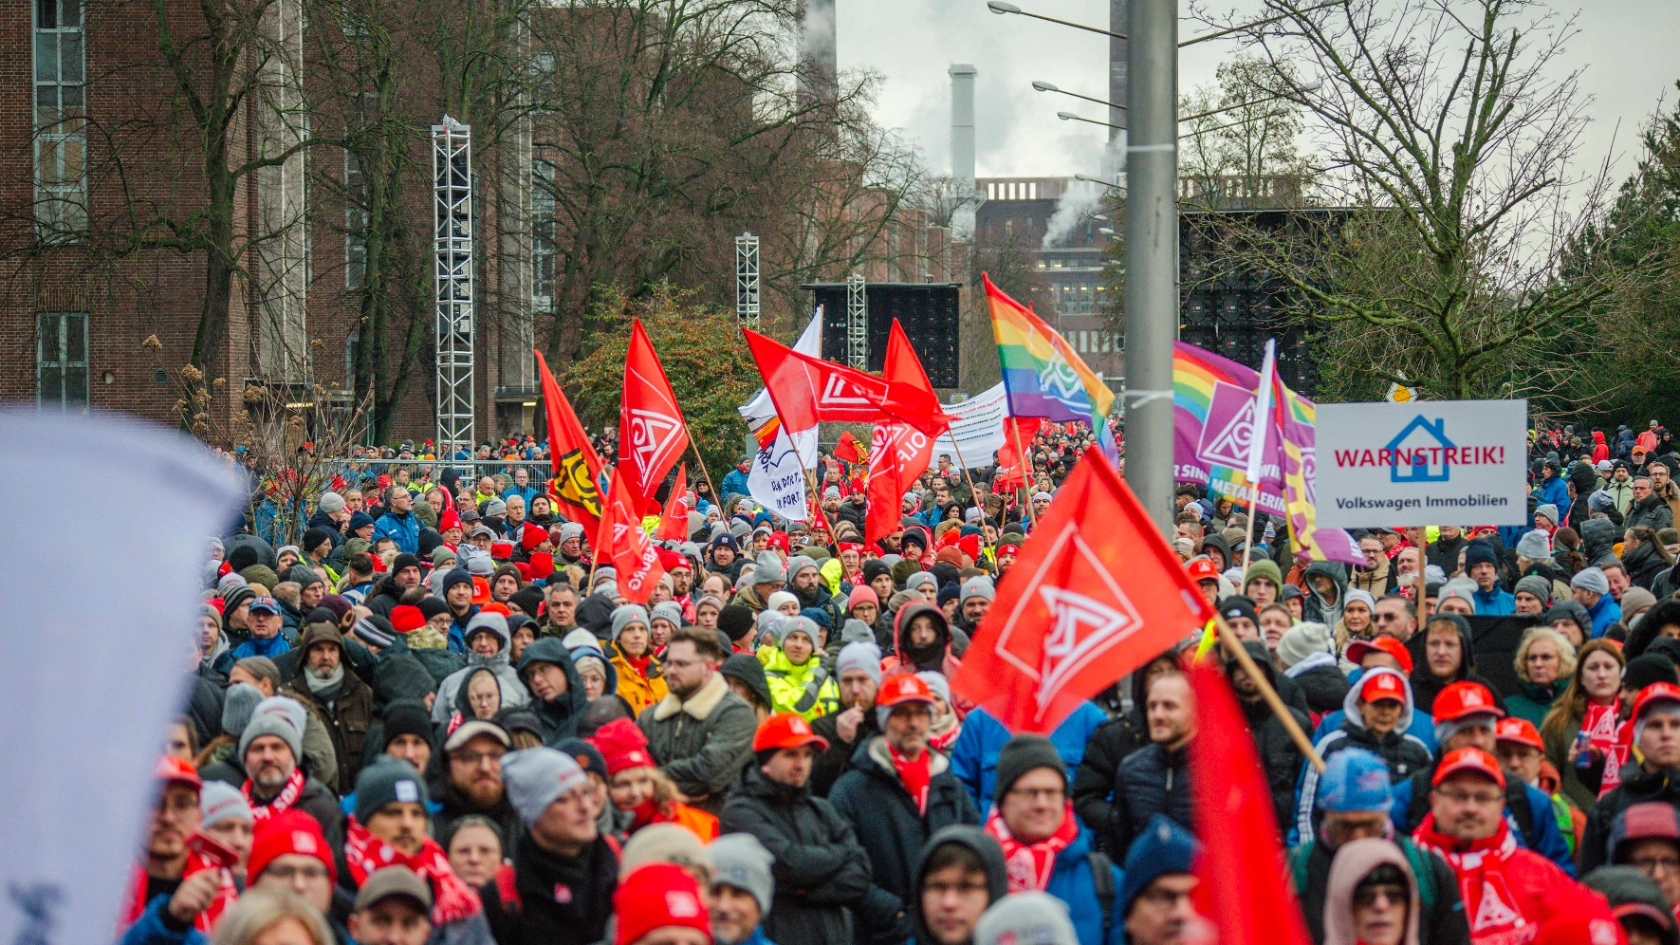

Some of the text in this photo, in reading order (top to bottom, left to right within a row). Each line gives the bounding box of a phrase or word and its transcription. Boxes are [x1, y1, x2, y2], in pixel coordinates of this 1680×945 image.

[1335, 446, 1505, 468] WARNSTREIK!
[1336, 494, 1508, 511] Volkswagen Immobilien
